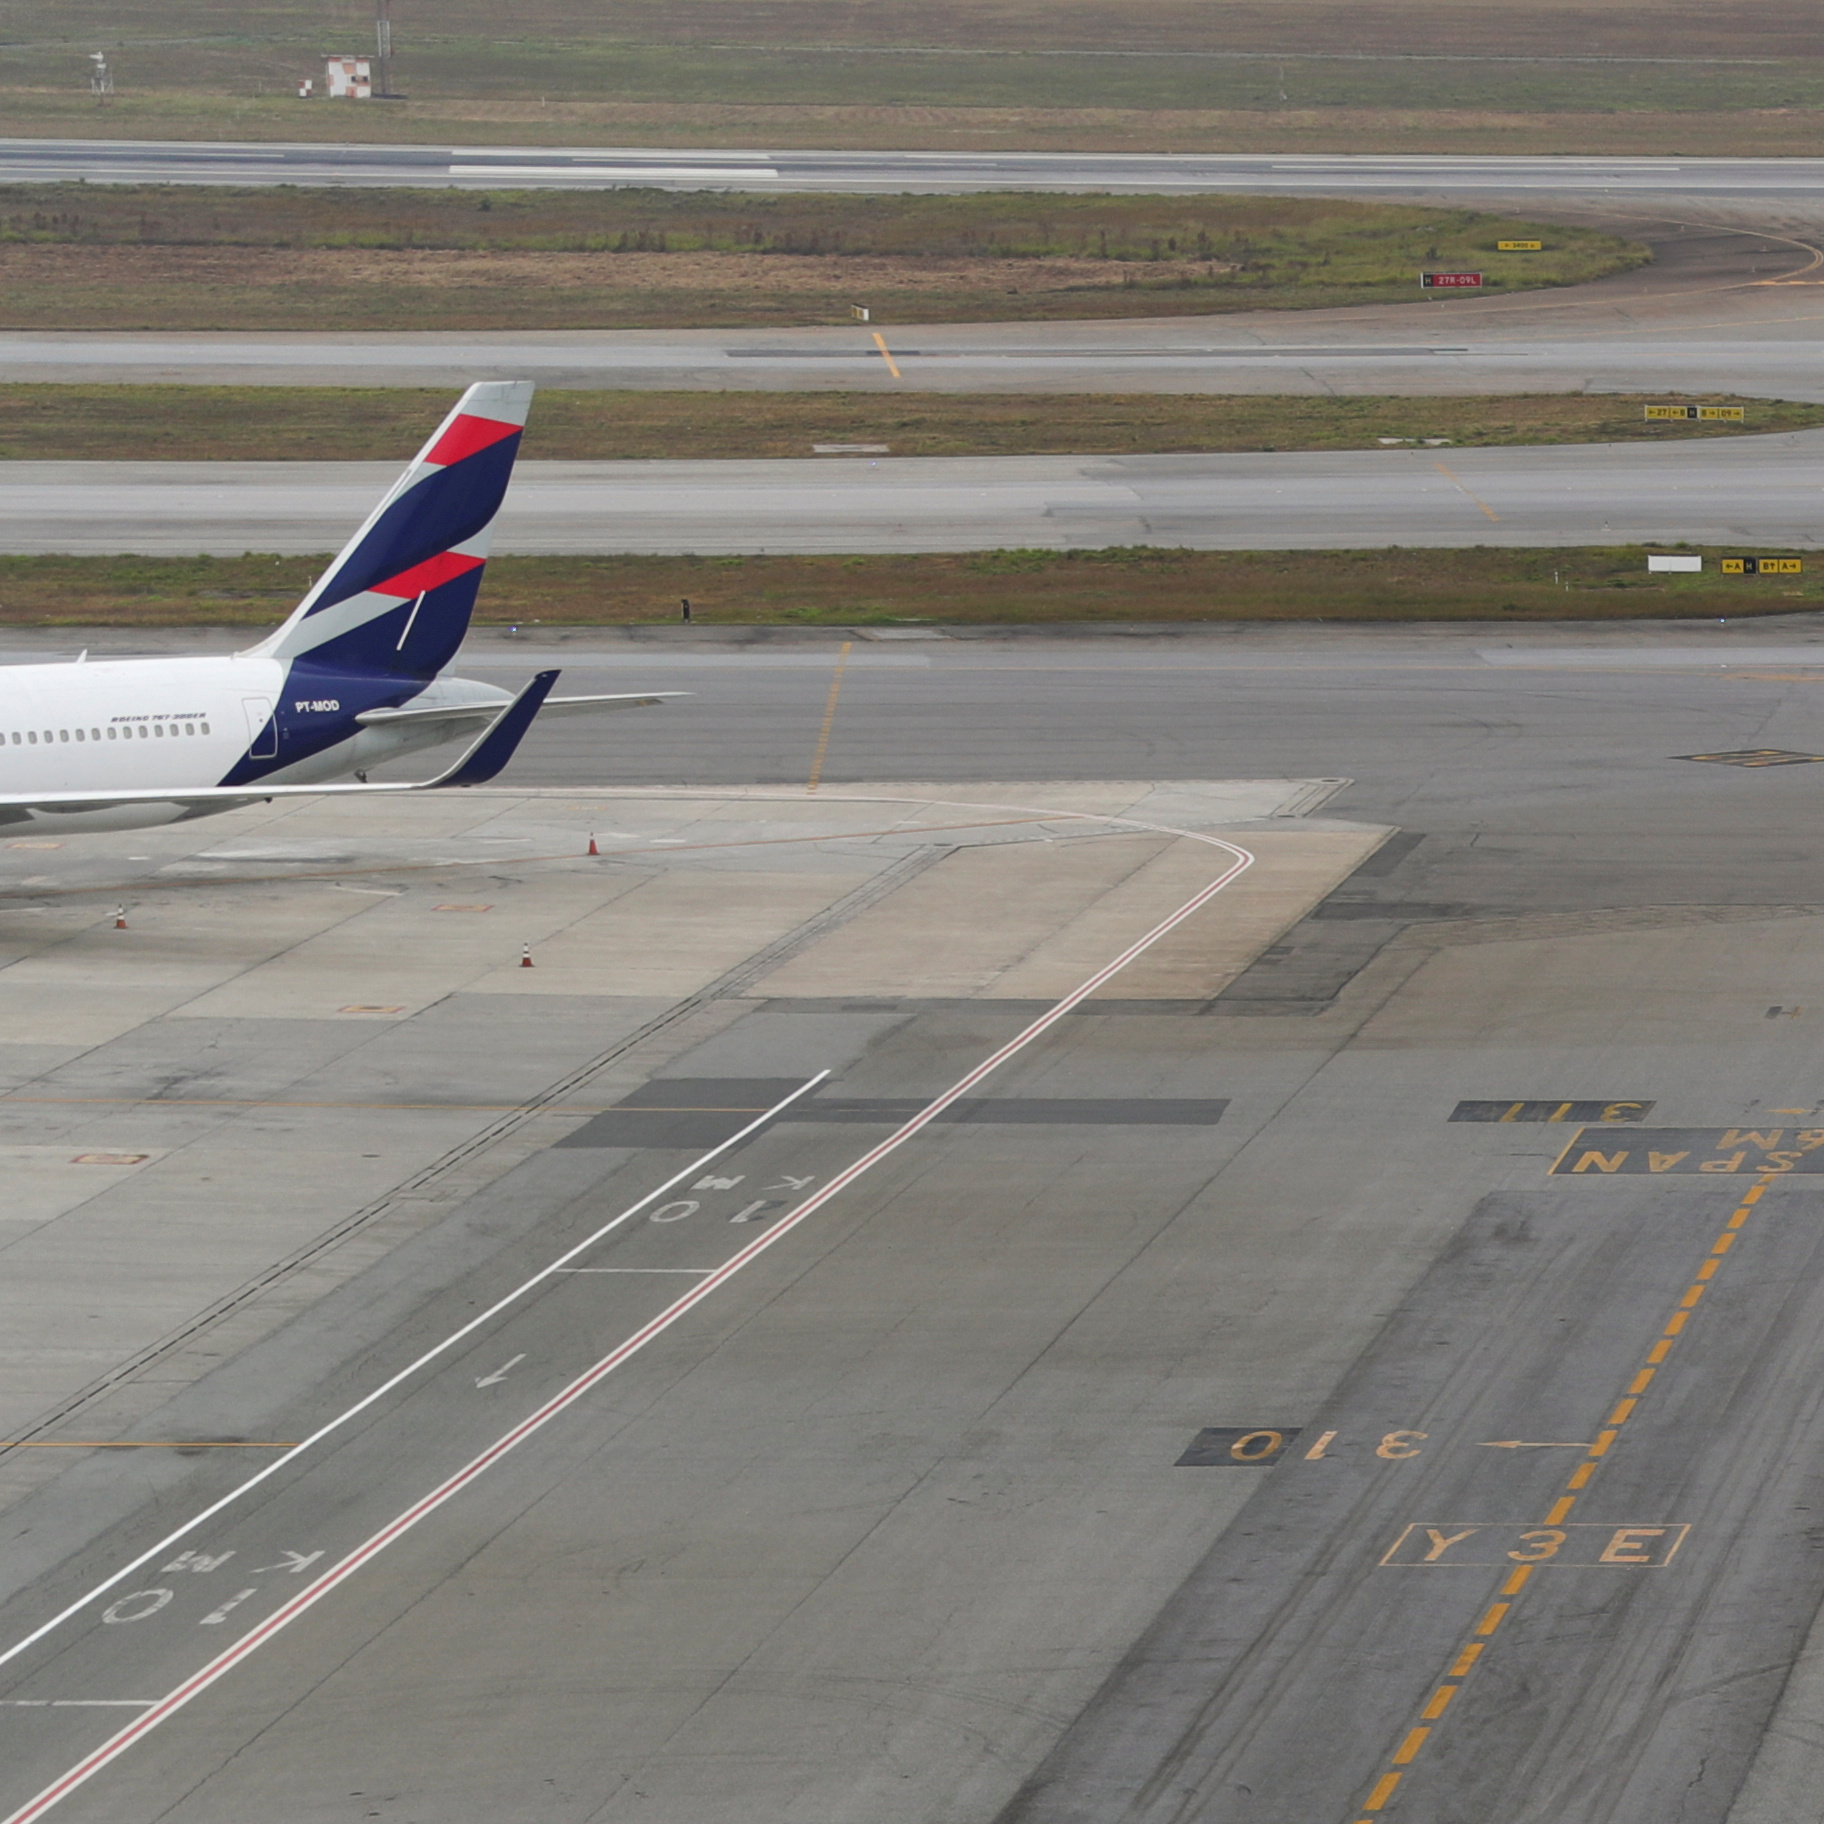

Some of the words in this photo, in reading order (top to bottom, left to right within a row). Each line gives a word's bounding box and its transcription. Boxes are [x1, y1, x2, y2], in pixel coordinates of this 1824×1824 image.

[1438, 276, 1477, 285] 27R-09L
[295, 700, 340, 713] PT-MOD
[1502, 1102, 1643, 1123] 311
[1571, 1150, 1802, 1173] SPAN
[1229, 1430, 1430, 1462] 310
[1425, 1529, 1667, 1563] Y3E
